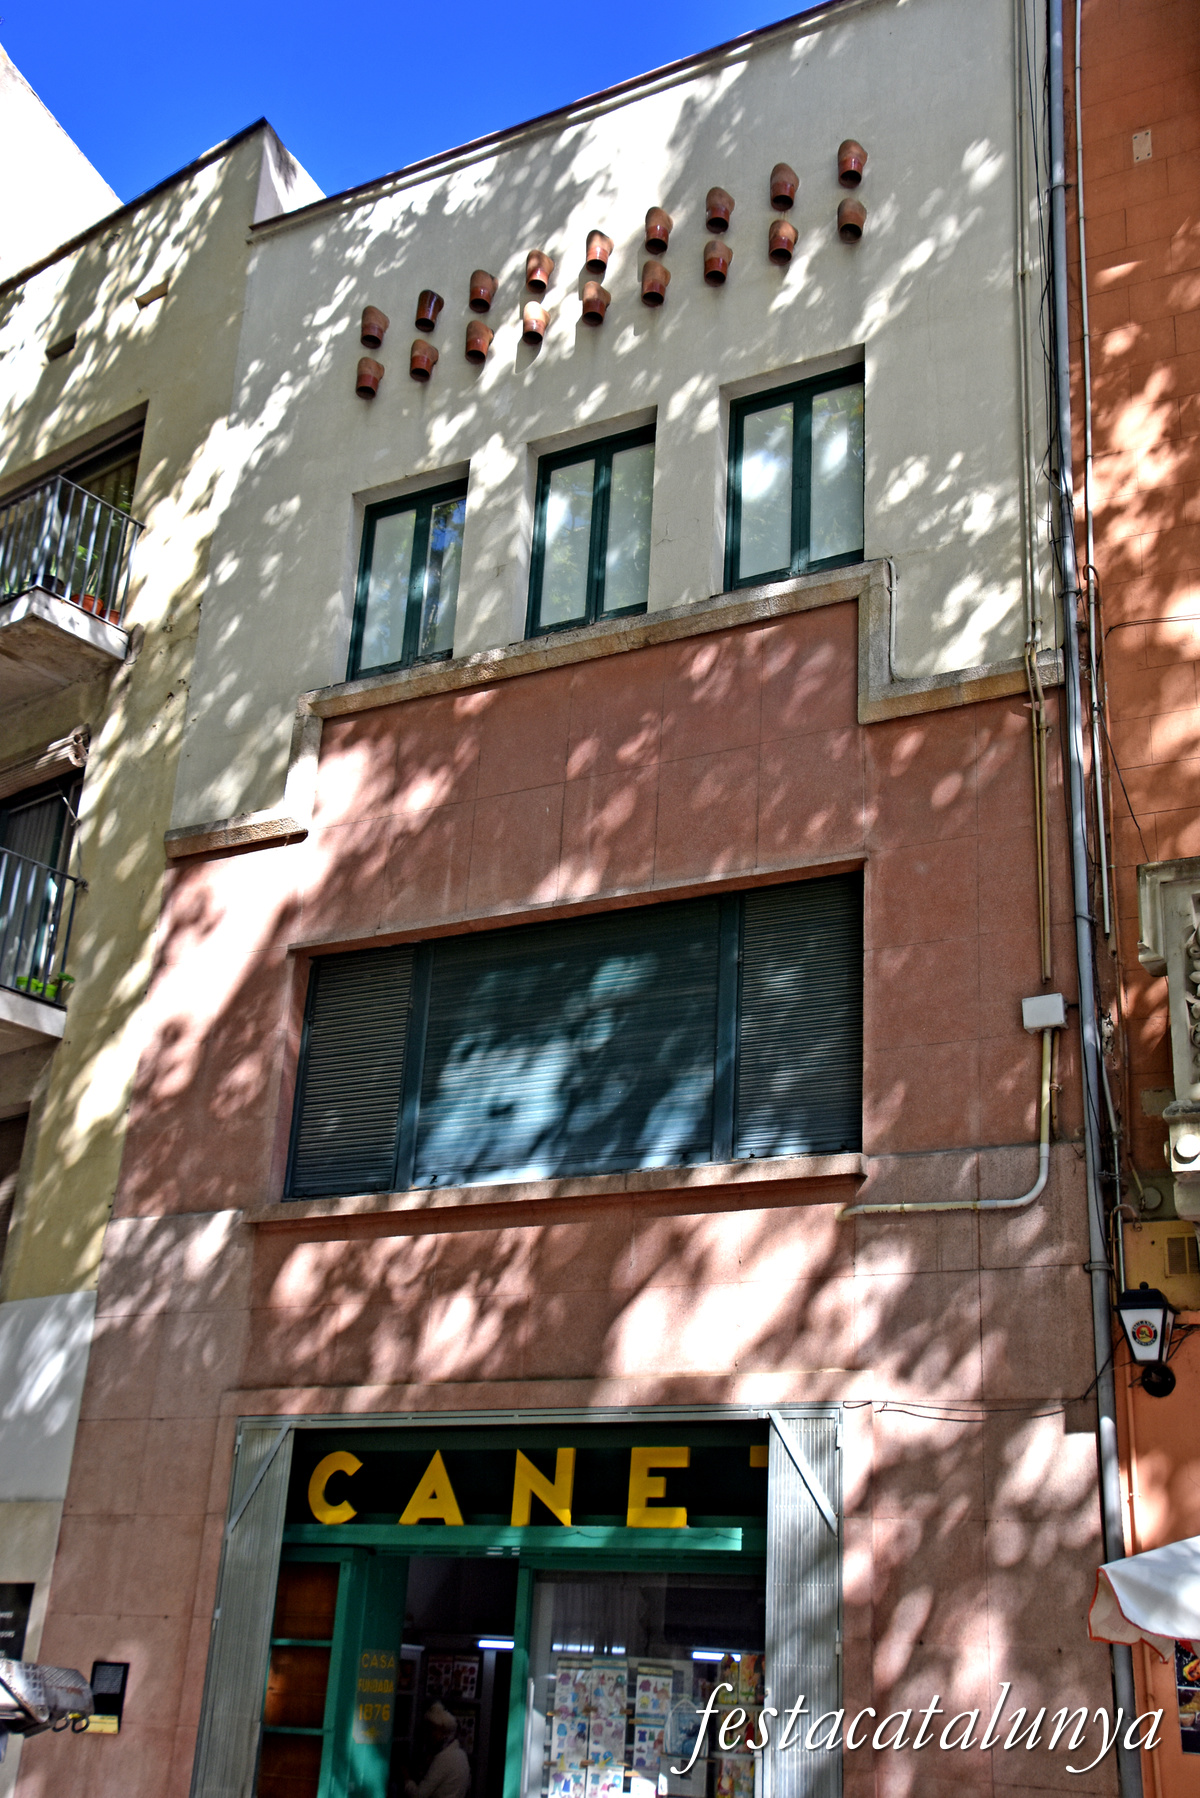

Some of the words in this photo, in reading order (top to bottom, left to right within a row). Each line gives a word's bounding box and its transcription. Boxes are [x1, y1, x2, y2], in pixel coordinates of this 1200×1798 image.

[307, 1445, 769, 1527] CANE
[361, 1653, 395, 1669] CASA
[358, 1678, 395, 1693] FUNDADA
[358, 1703, 391, 1721] 1876
